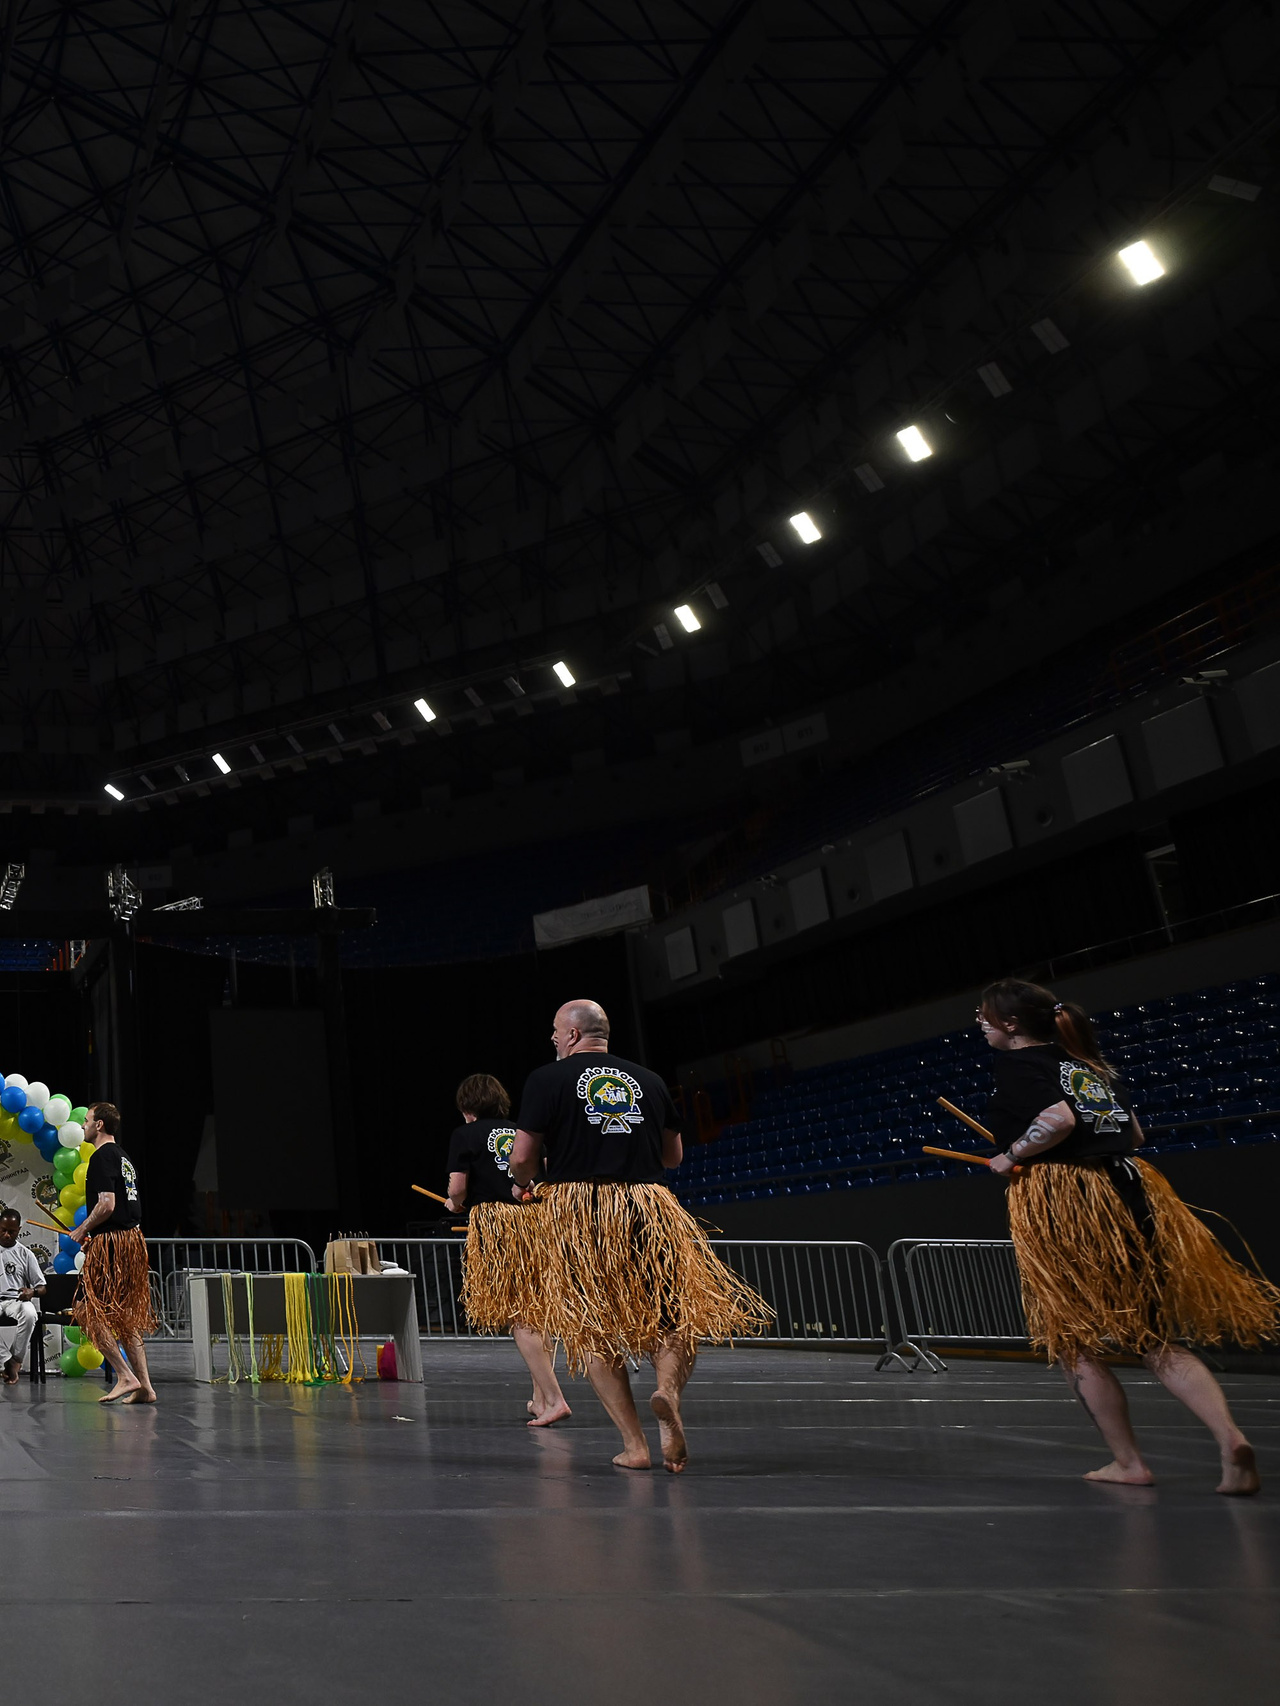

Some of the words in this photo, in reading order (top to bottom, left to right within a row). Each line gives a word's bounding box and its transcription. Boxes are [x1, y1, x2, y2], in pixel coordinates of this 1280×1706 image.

[603, 1067, 619, 1076] DE
[620, 1072, 643, 1098] OURO
[39, 1244, 51, 1257] OURO
